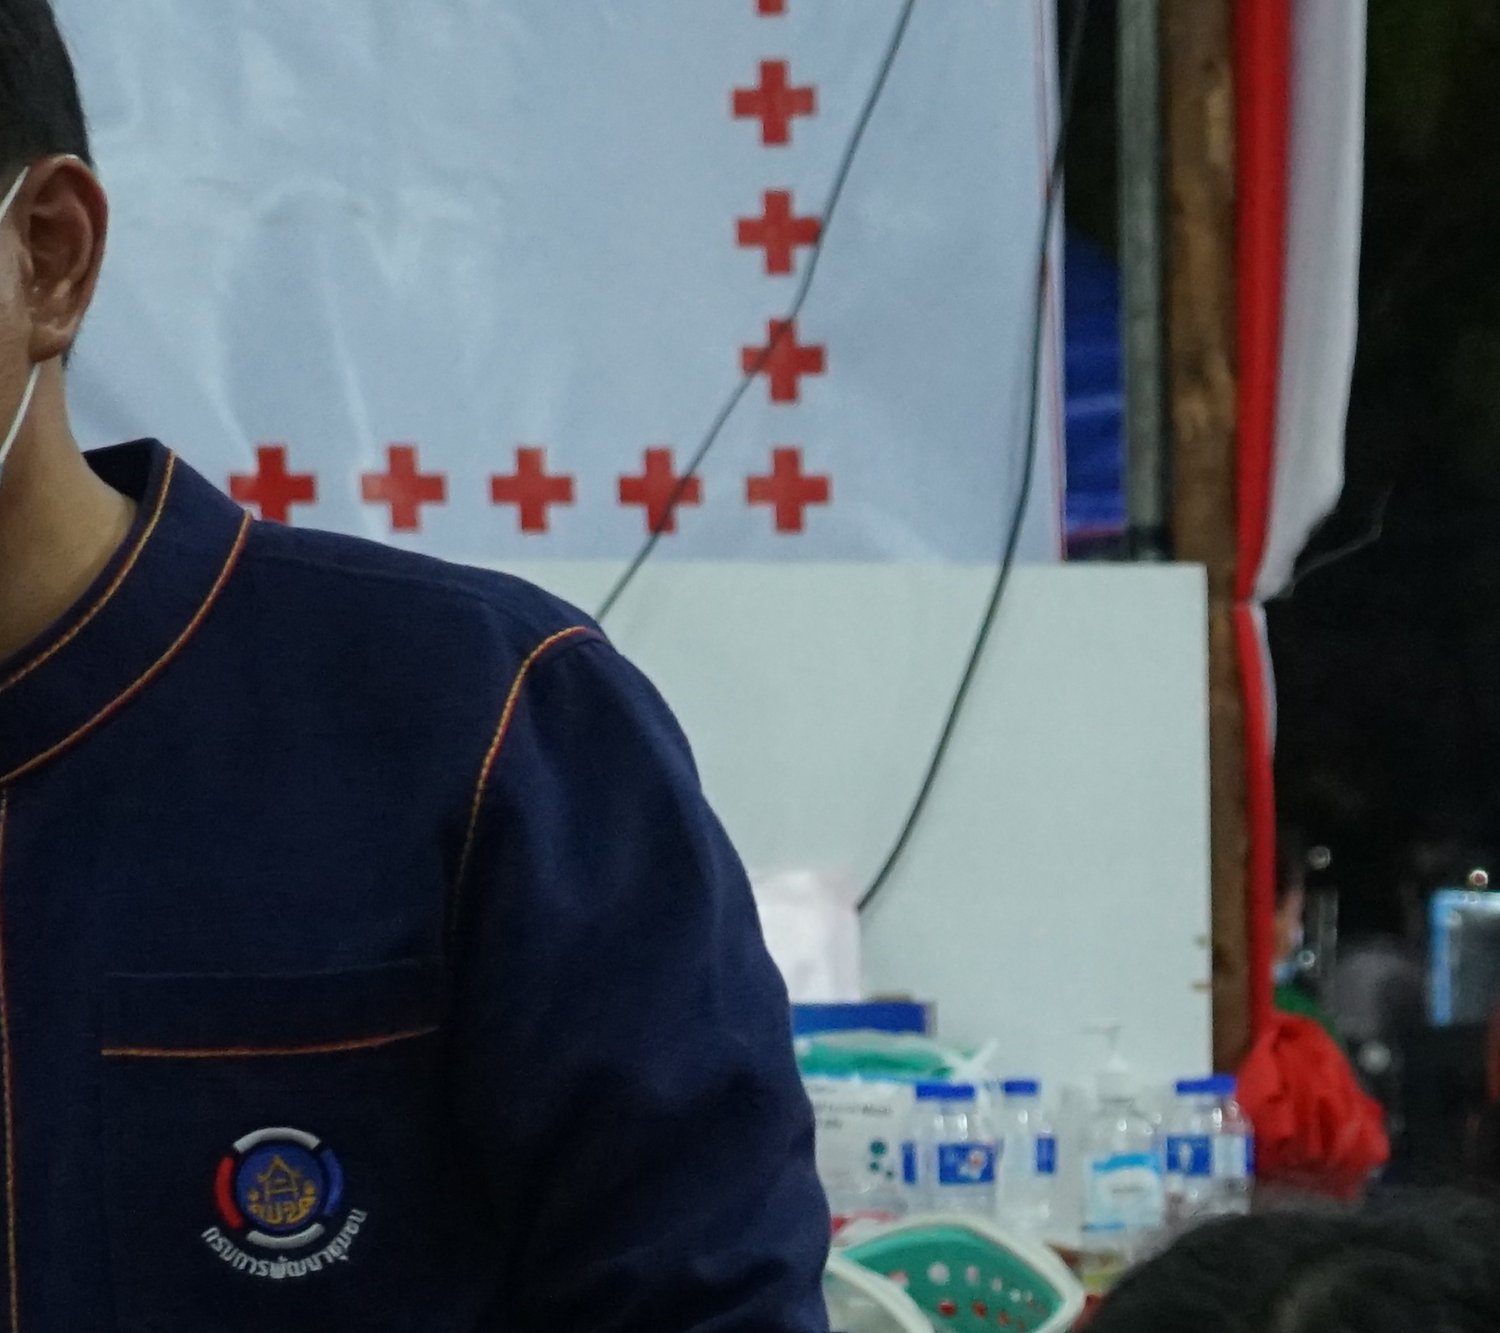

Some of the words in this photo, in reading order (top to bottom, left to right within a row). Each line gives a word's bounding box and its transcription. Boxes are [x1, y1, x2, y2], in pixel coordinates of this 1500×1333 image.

[201, 1207, 368, 1279] กรมการพัฒนาชุมชน
